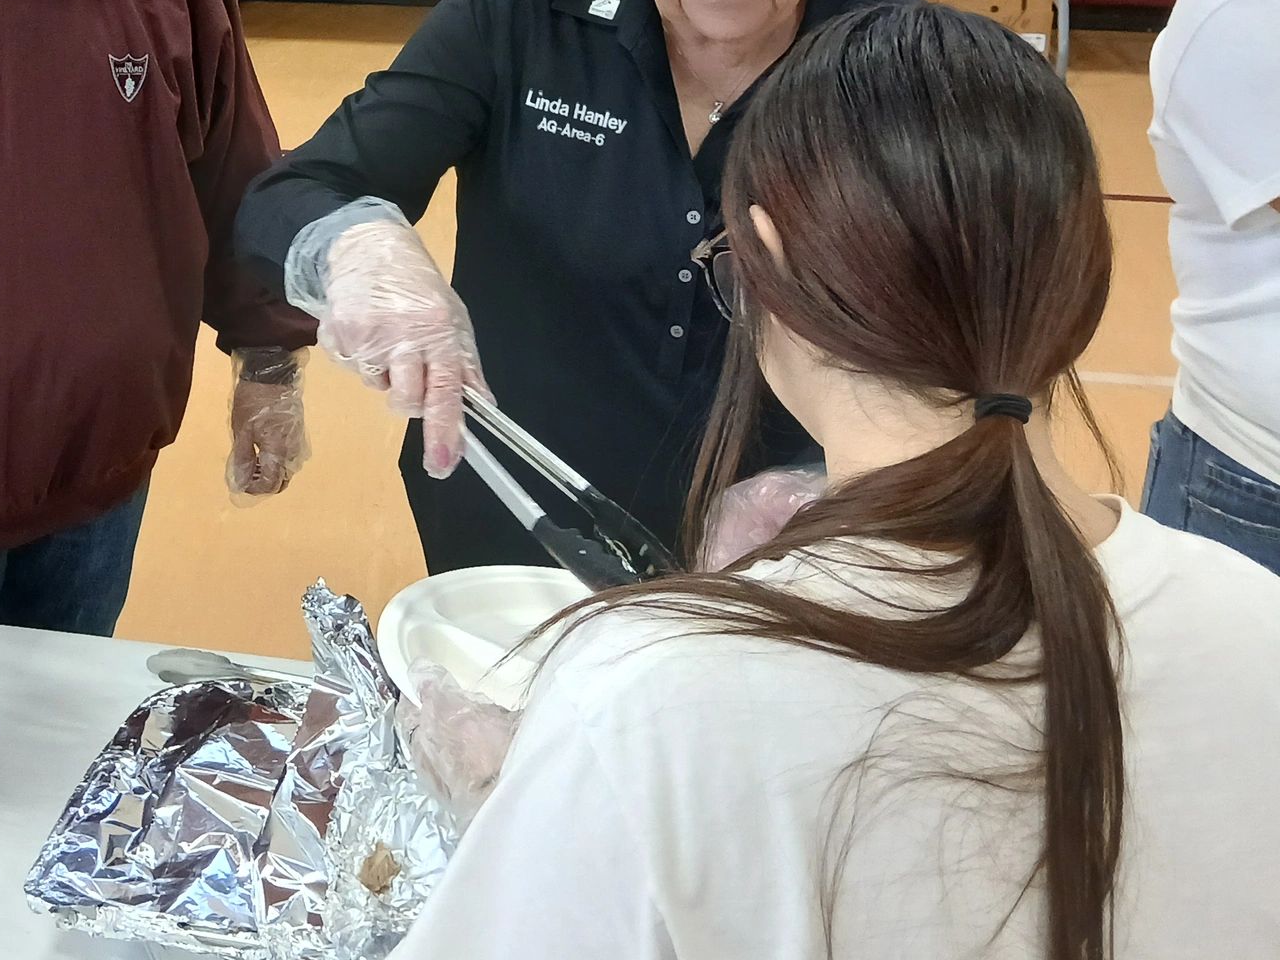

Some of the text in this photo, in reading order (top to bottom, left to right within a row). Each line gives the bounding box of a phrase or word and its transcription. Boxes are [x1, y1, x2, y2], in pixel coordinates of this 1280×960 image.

[525, 89, 628, 134] Linda Hanley
[537, 117, 606, 146] AG-Area-6
